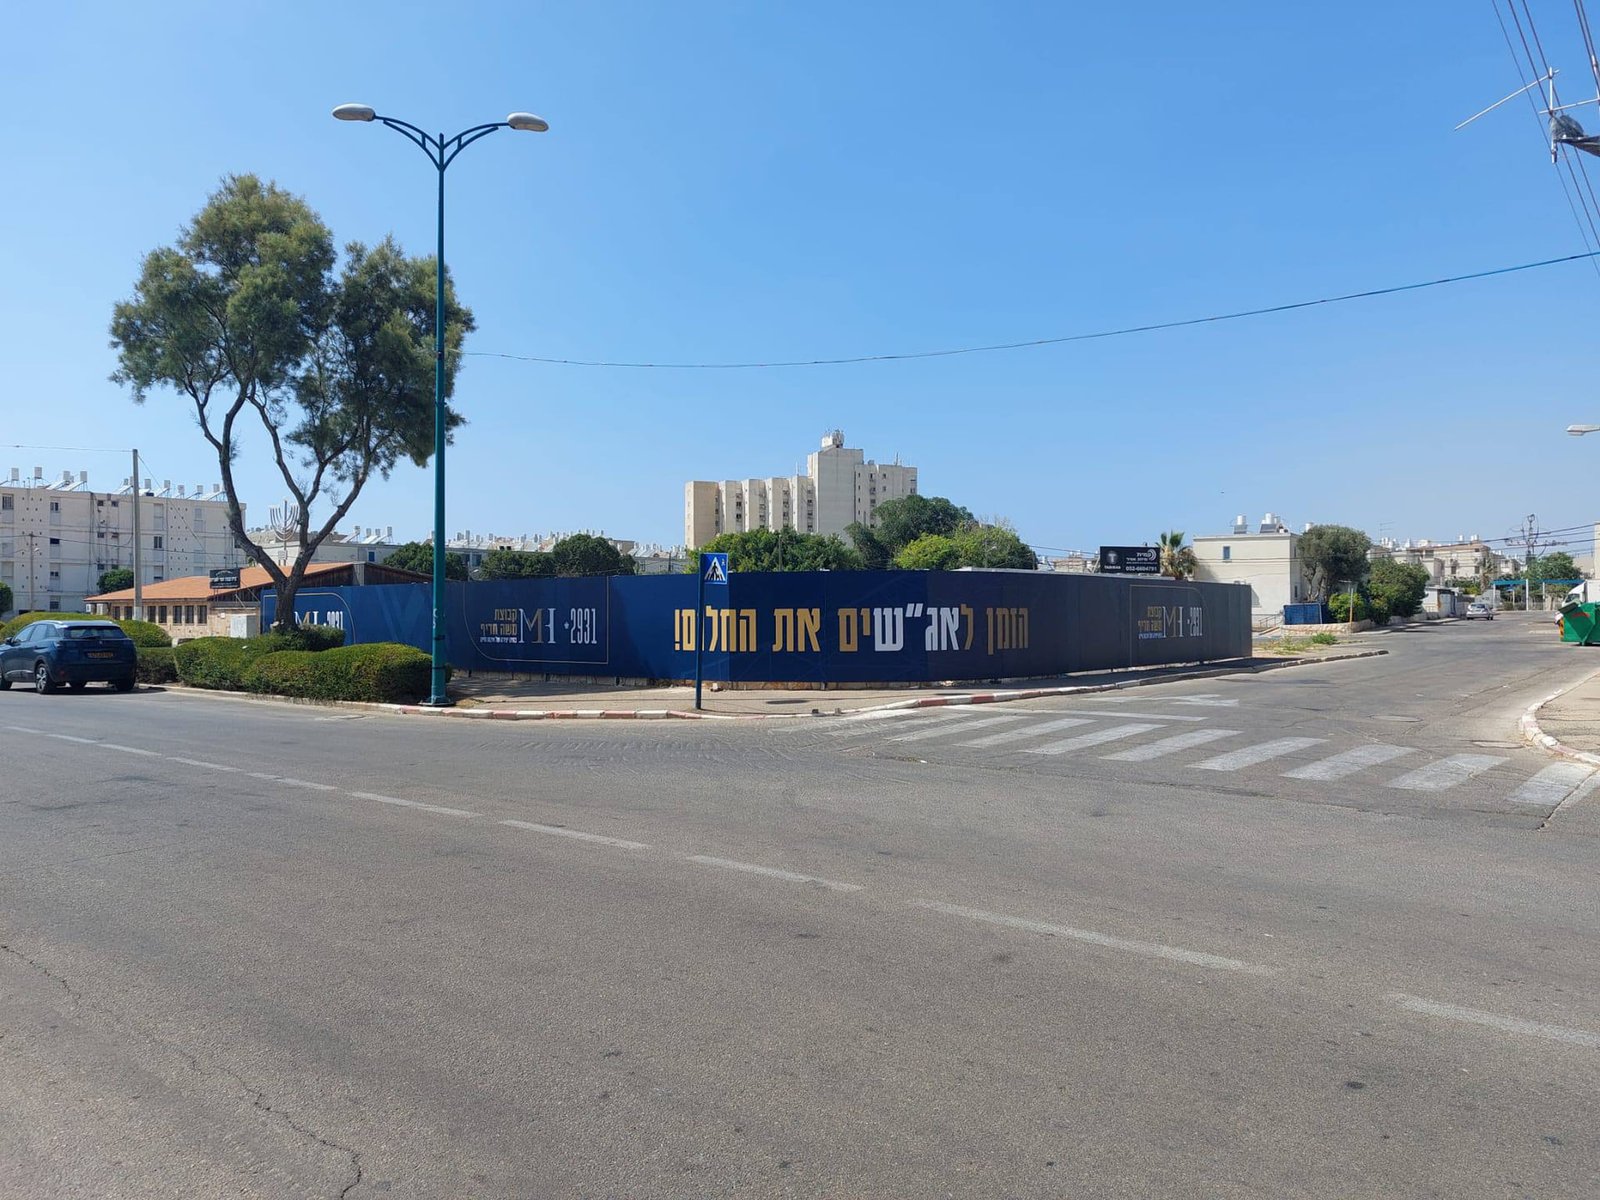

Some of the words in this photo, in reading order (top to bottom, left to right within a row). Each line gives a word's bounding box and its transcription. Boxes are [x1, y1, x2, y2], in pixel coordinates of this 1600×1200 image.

[480, 623, 498, 637] חריף
[494, 608, 518, 623] קבוצת
[499, 623, 518, 636] משה
[570, 608, 598, 644] 2931
[674, 605, 757, 652] החלם!
[772, 608, 821, 652] את
[986, 607, 1029, 655] הזמן
